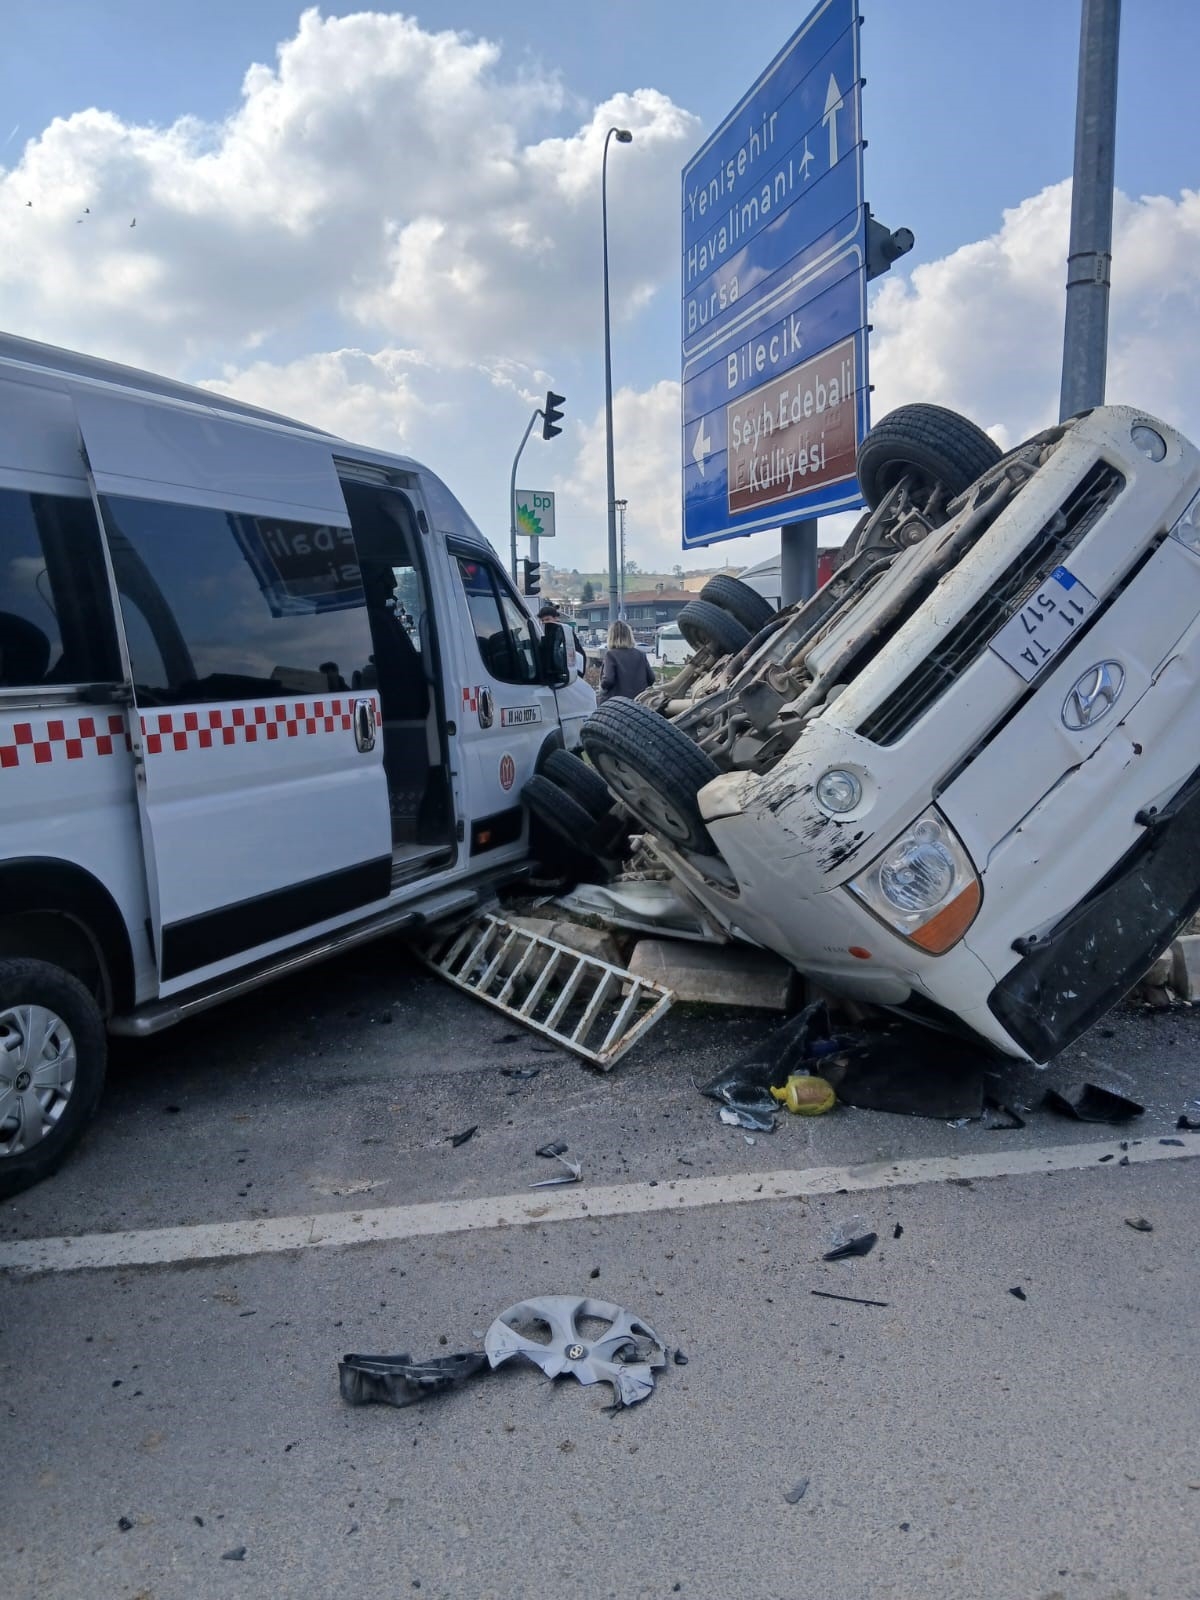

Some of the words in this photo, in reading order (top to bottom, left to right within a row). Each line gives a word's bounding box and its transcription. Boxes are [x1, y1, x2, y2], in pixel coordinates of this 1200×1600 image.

[688, 111, 778, 222] Yenişehir
[688, 159, 793, 282] Havalimanı
[688, 275, 740, 334] Bursa
[727, 314, 802, 390] Bilecik
[732, 402, 773, 453] Şeyh
[779, 358, 852, 431] Edebali
[749, 432, 826, 494] Külliyesi
[533, 493, 551, 511] bp
[1020, 593, 1057, 635] 517
[1058, 599, 1083, 626] 11
[1020, 639, 1051, 667] TA
